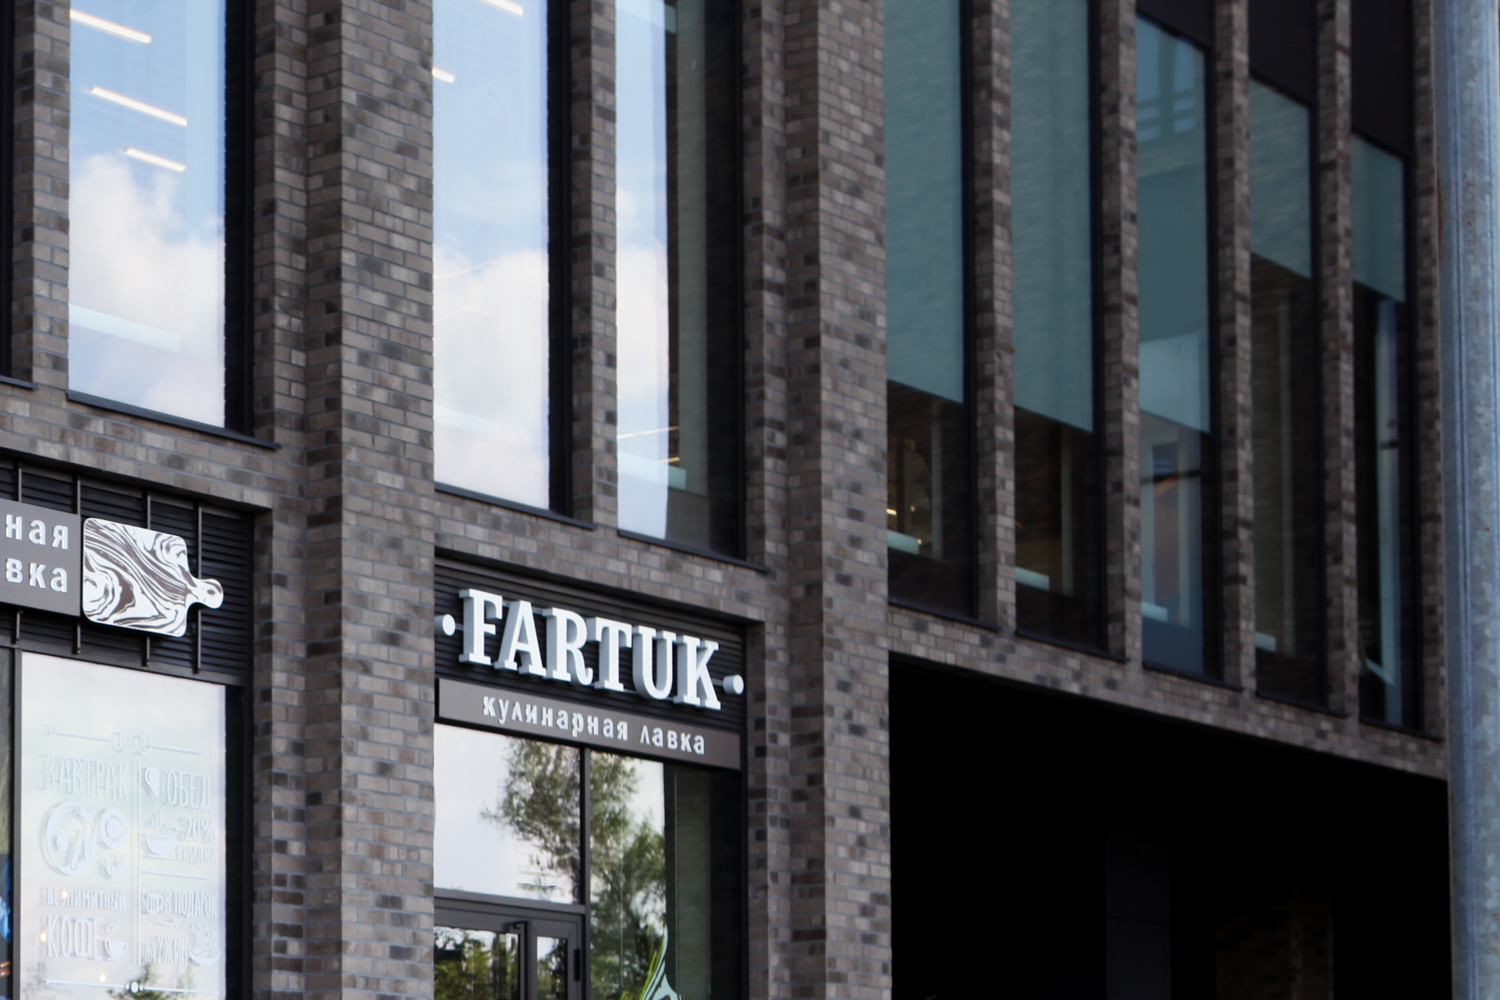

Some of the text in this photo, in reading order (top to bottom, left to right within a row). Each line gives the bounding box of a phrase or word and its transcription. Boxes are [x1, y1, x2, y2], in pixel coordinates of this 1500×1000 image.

[483, 695, 706, 755] кулинарная лавка
[46, 754, 130, 801] ЗАВТРАК
[167, 770, 213, 814] ОБЕД
[175, 845, 218, 865] СКИДКА
[174, 890, 218, 918] ПОДАРОК
[47, 914, 104, 961] КОФЕ
[156, 934, 188, 966] УЖИН
